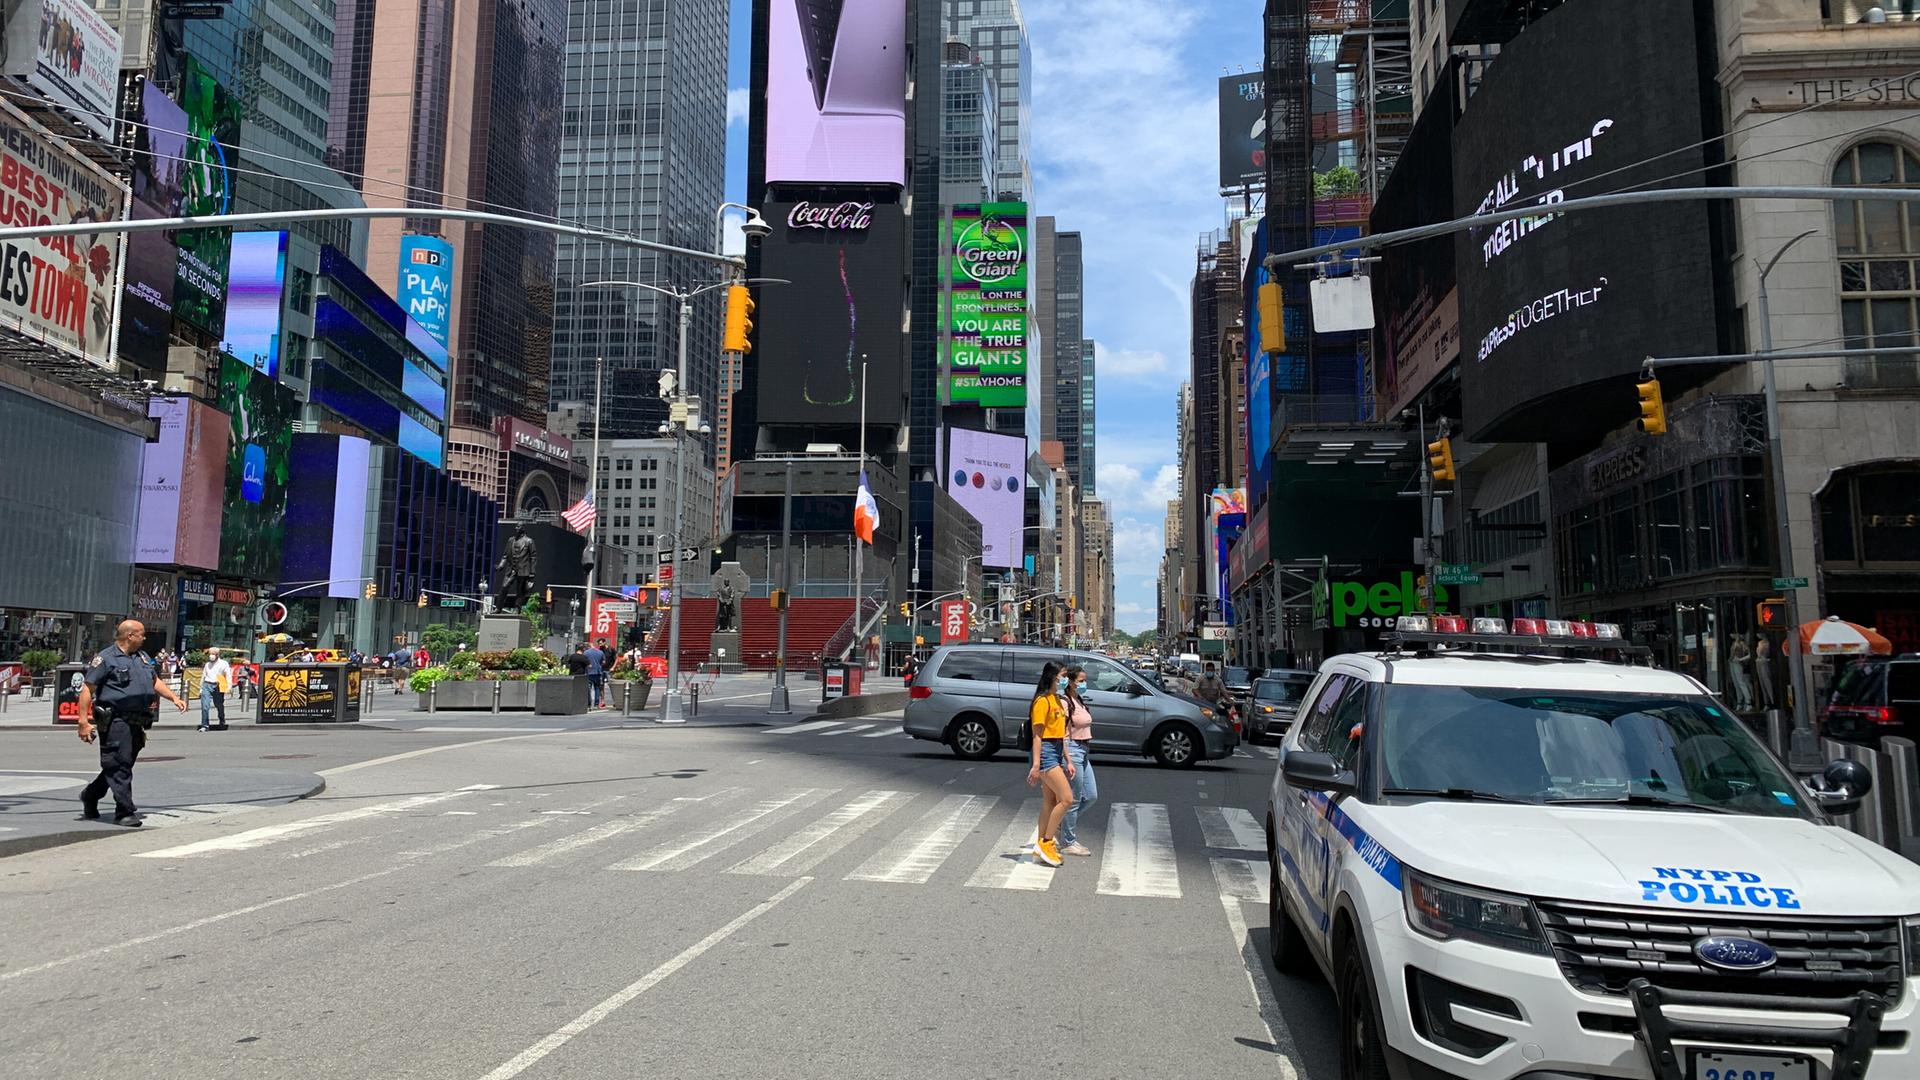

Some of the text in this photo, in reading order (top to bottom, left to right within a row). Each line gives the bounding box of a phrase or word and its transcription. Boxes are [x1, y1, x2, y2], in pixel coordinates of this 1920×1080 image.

[1794, 79, 1856, 103] THE
[2, 152, 64, 217] BEST
[38, 145, 46, 170] 8
[47, 152, 71, 186] TONY
[71, 168, 108, 211] AWARDS
[787, 200, 876, 230] Coca-Cola
[964, 247, 1018, 262] Green
[177, 262, 188, 280] 30
[188, 253, 212, 278] NOTHING
[211, 265, 223, 284] FOR
[970, 261, 1019, 277] Giant
[0, 242, 88, 342] ESTOWN
[125, 283, 173, 315] RESPONDER
[137, 281, 162, 299] RAPID
[956, 290, 1023, 301] TO ALL ON THE
[955, 303, 1023, 313] FRONTLINES.
[956, 319, 1022, 333] YOU ARE
[955, 335, 1022, 348] THE TRUE
[954, 350, 1022, 366] GIANTS
[954, 376, 1022, 387] #STAYHOME
[243, 460, 263, 486] Calm
[1590, 446, 1642, 489] EXPRESS
[143, 484, 178, 492] SWAROVSKI
[1452, 566, 1462, 575] 46
[1460, 574, 1479, 582] Equity
[184, 579, 215, 594] BLUE FIN
[138, 599, 169, 611] SWAROVSKI
[947, 603, 964, 636] tkts
[1358, 833, 1390, 875] POLICE
[1652, 866, 1762, 884] NYPD
[1638, 880, 1802, 909] POLICE
[1716, 940, 1760, 962] Ford
